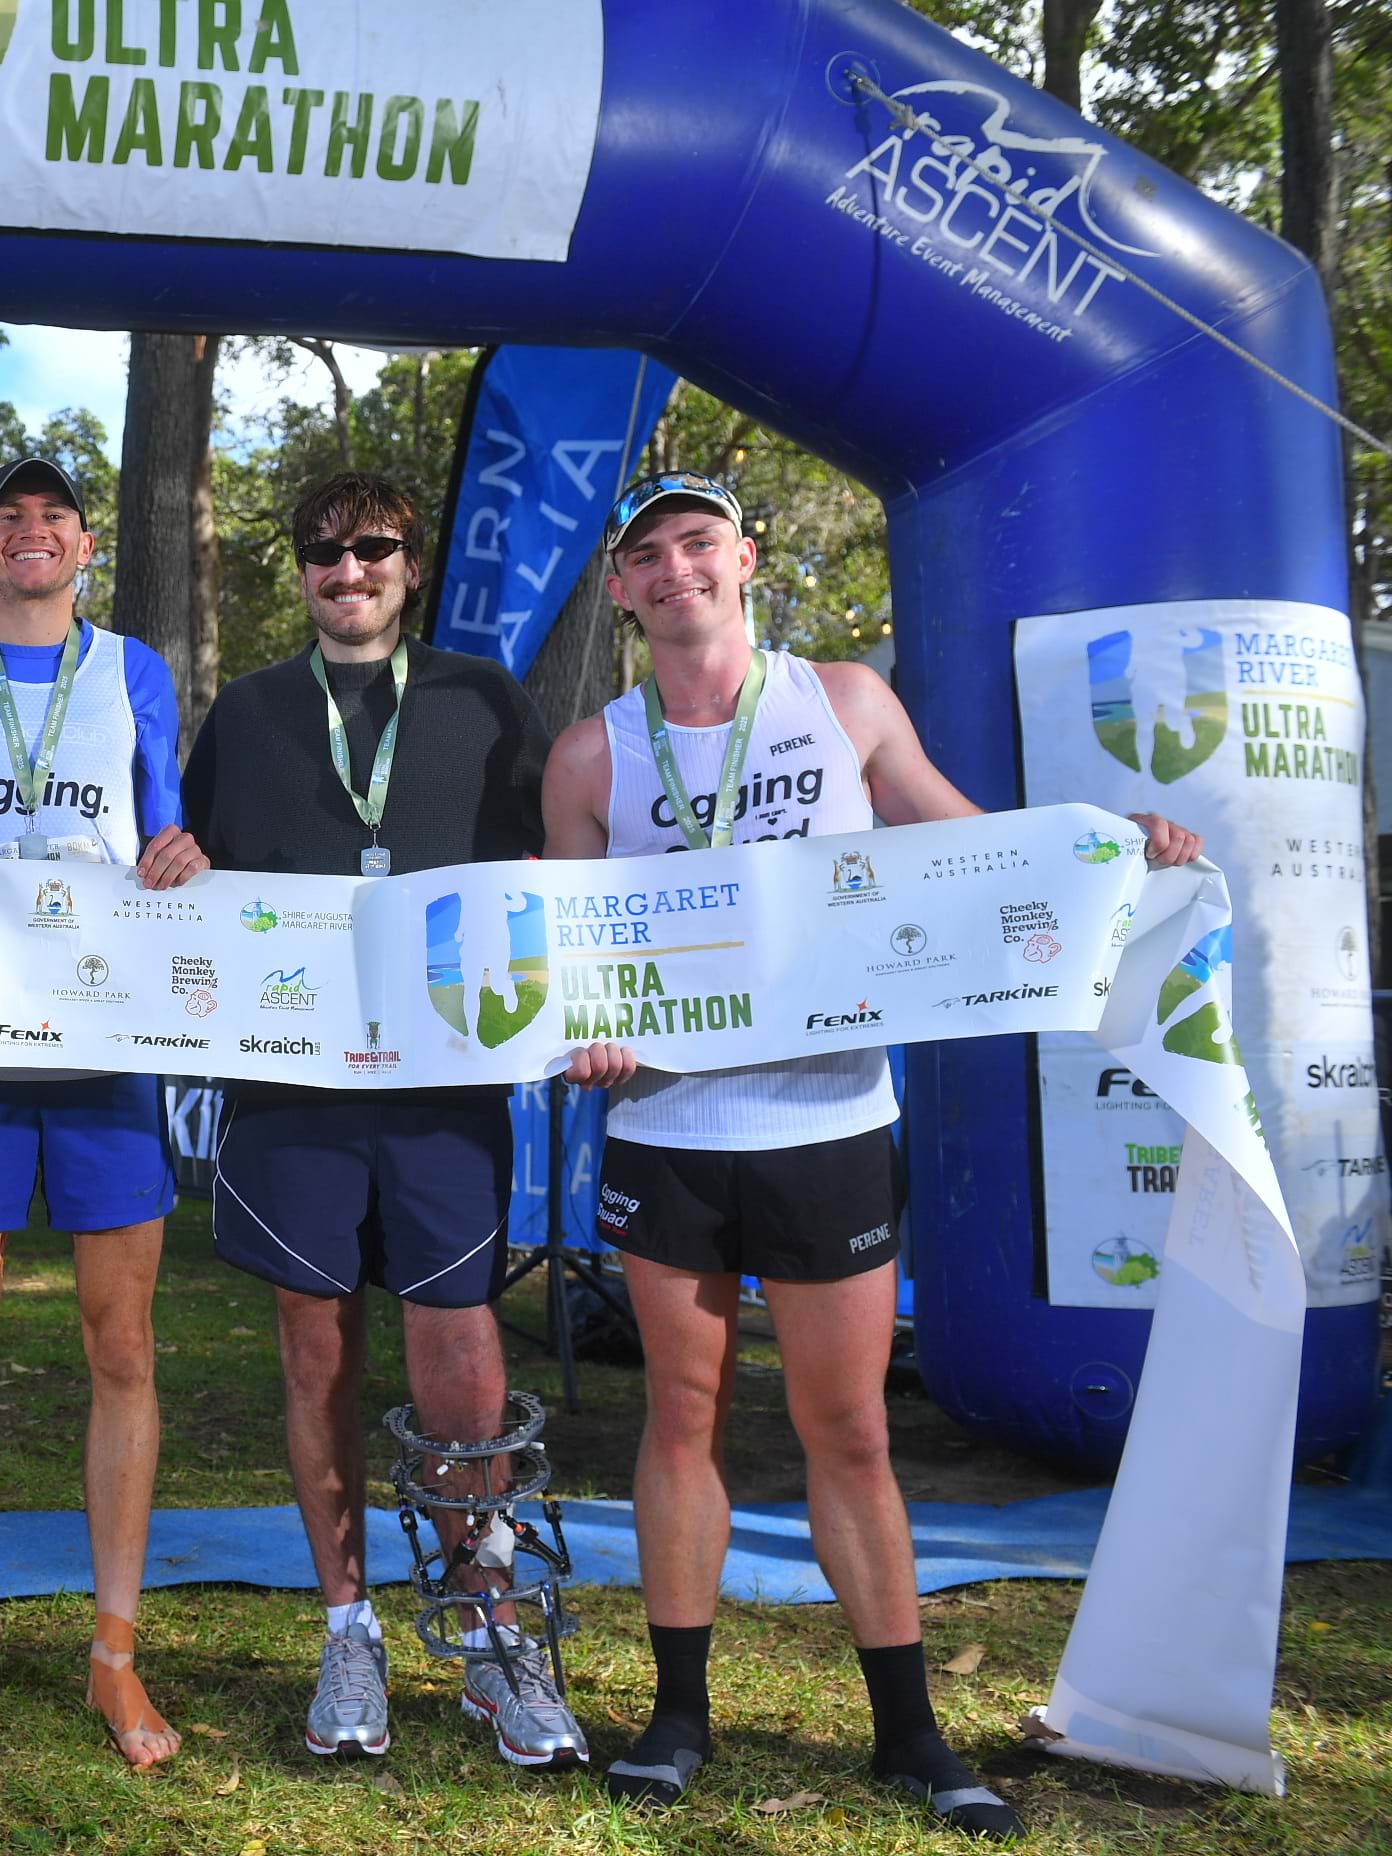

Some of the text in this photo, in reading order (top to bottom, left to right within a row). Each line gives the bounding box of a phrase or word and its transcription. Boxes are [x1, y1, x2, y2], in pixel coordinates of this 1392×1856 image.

[51, 0, 301, 76] ULTRA
[44, 72, 481, 187] MARATHON
[902, 111, 1082, 231] rapid
[846, 134, 1127, 317] ASCENT
[825, 186, 1073, 343] Adventure Event Management
[1237, 661, 1320, 687] RIVER
[1241, 703, 1327, 742] ULTRA
[769, 733, 816, 757] PERENE
[931, 849, 1019, 867] WESTERN
[923, 859, 1030, 880] AUSTRALIA
[122, 900, 196, 911] WESTERN
[555, 882, 740, 919] MARGARET
[999, 901, 1049, 915] Cheeky
[113, 910, 204, 922] AUSTRALIA
[282, 911, 306, 920] SHIRE
[314, 912, 353, 921] AUGUSTA
[1001, 910, 1054, 924] Monkey
[282, 921, 353, 931] MARGARET RIVER
[557, 920, 652, 947] RIVER
[1002, 918, 1059, 935] Brewing
[1003, 934, 1025, 944] Co.
[171, 956, 213, 967] Cheeky
[866, 958, 921, 973] HOWARD
[926, 953, 957, 964] PARK
[171, 966, 216, 978] Monkey
[171, 975, 219, 989] Brewing
[171, 985, 189, 995] Co.
[266, 979, 303, 994] rapid
[560, 961, 665, 1002] ULTRA
[52, 988, 132, 1000] HOWARD PARK
[260, 991, 318, 1006] ASCENT
[961, 983, 1060, 1007] TARKINE
[562, 992, 754, 1041] MARATHON
[131, 1033, 212, 1049] TARKINE
[239, 1034, 314, 1056] skratch
[343, 1050, 402, 1063] TRIBE&TRAIL
[848, 1223, 892, 1255] PERENE
